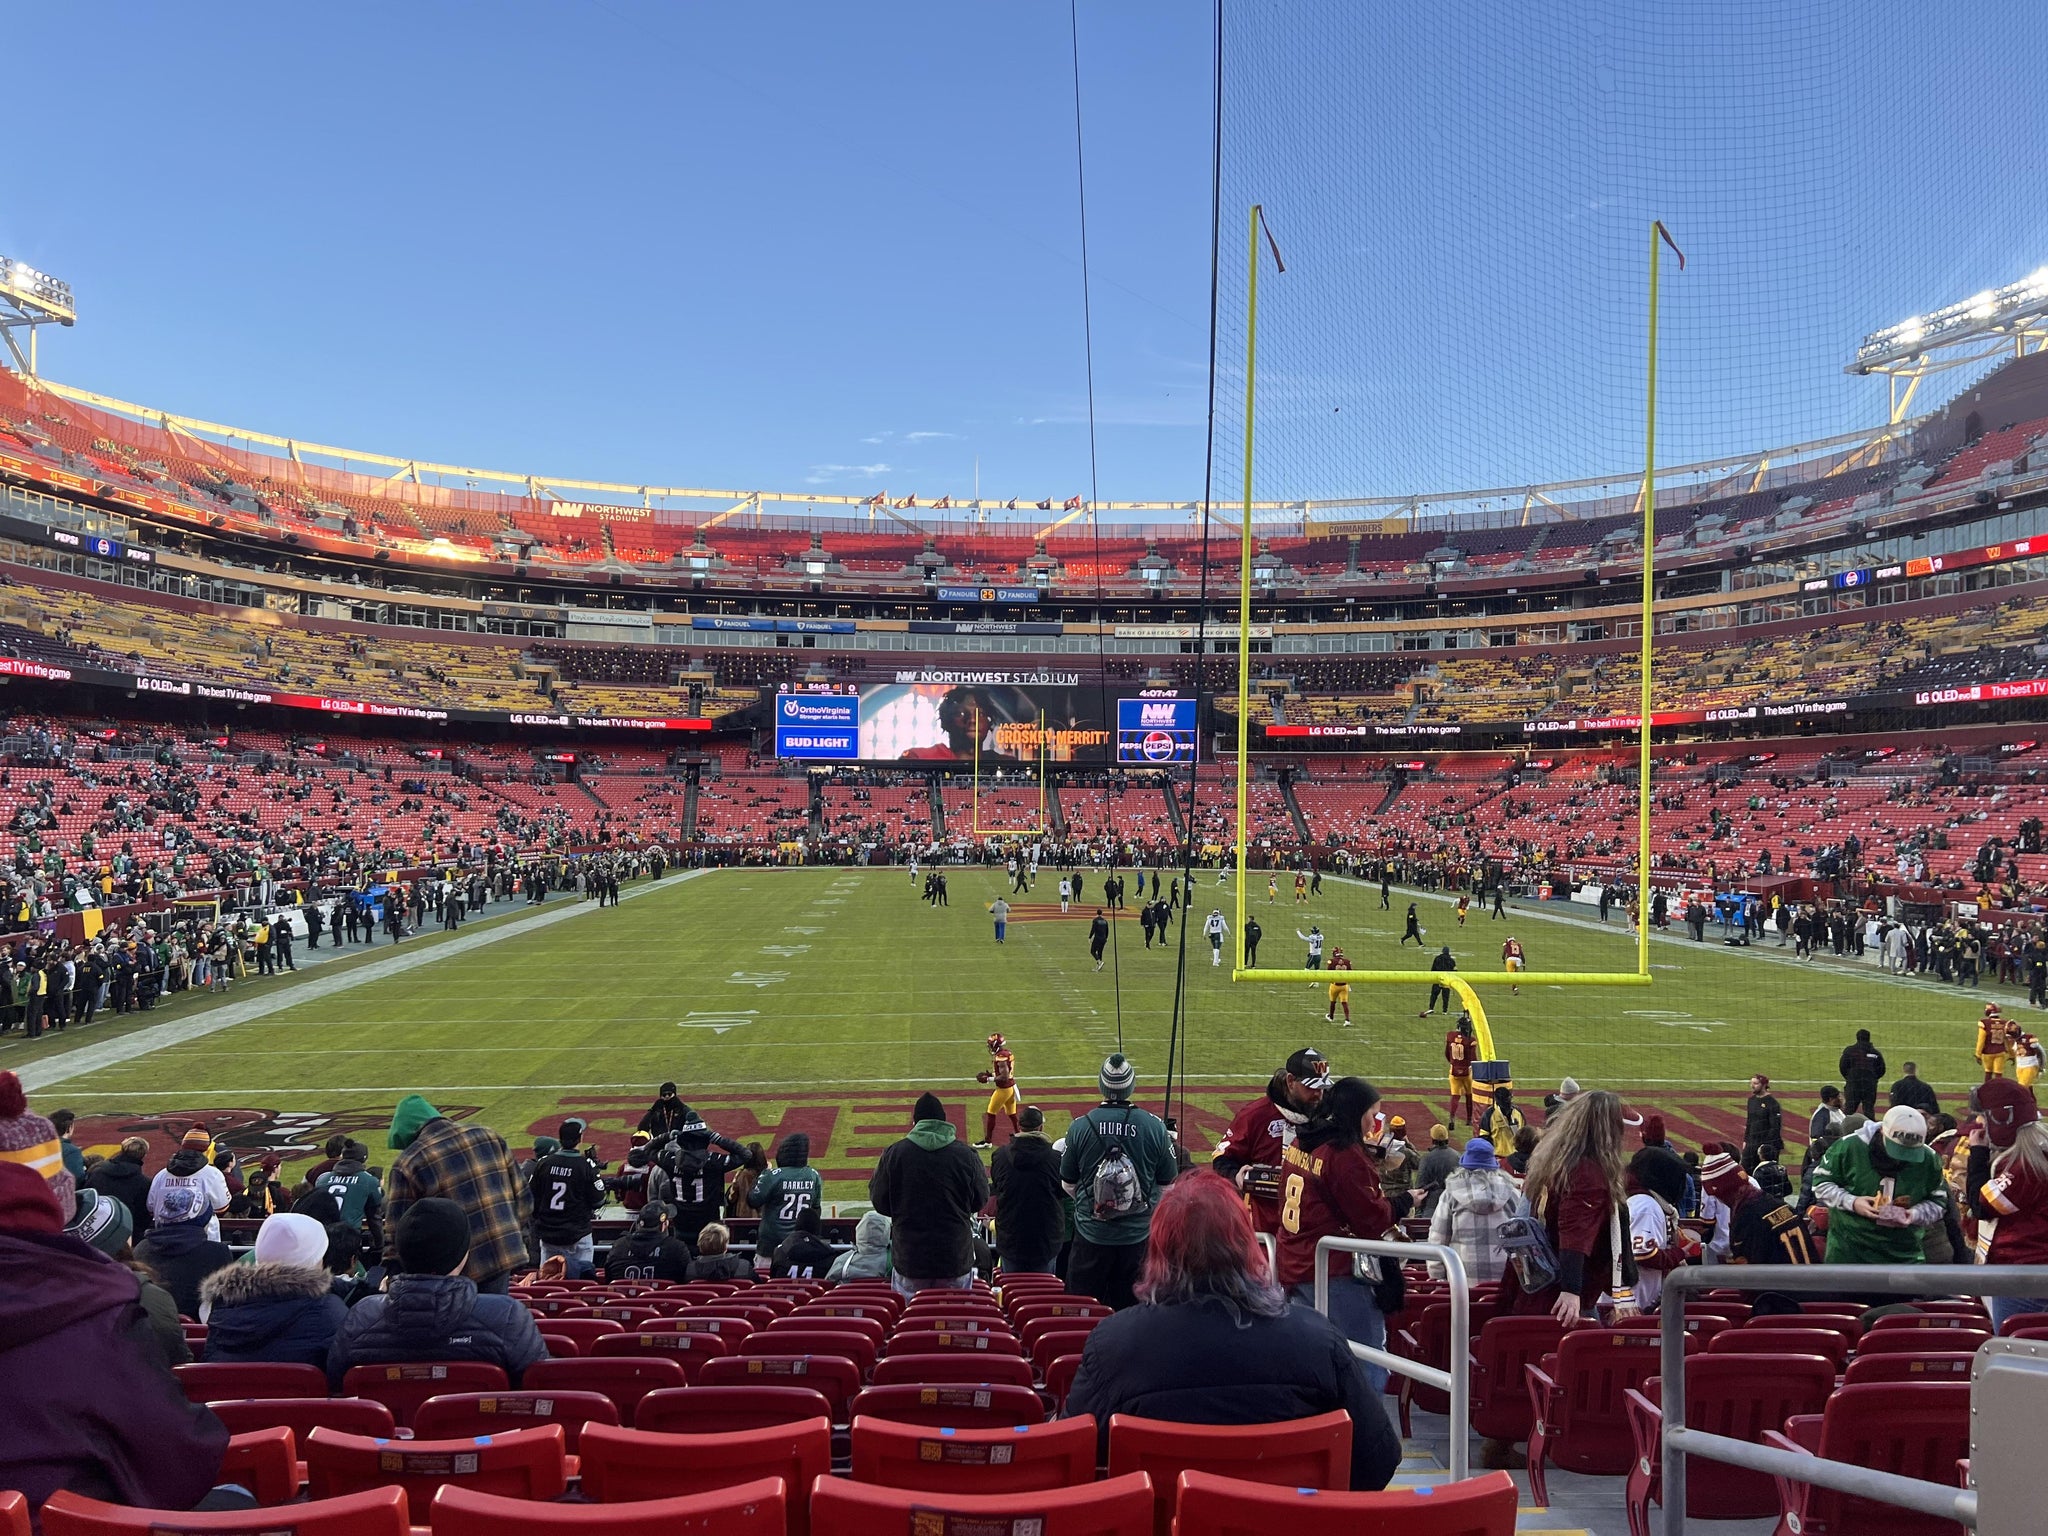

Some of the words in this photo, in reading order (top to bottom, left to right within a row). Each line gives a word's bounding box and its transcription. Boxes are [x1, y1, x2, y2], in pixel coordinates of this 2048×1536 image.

[586, 504, 652, 518] NORTHWEST
[600, 514, 638, 522] STADIUM
[1328, 524, 1382, 534] COMMANDERS
[54, 532, 79, 546] PEPSI
[127, 548, 150, 561] PEPSI
[1804, 580, 1828, 590] PEPSI
[1876, 566, 1902, 578] PEPSI
[982, 590, 993, 599] 25
[13, 662, 25, 673] TV
[26, 664, 34, 674] in
[34, 665, 47, 676] the
[48, 668, 71, 680] game
[921, 672, 1010, 682] NORTHWEST
[1013, 673, 1078, 683] STADIUM
[137, 678, 149, 690] LG
[150, 679, 173, 692] OLED
[1992, 686, 2009, 696] The
[2010, 684, 2031, 696] best
[2032, 682, 2046, 693] TV
[197, 685, 208, 696] The
[210, 686, 226, 698] best
[226, 688, 236, 699] TV
[236, 690, 243, 699] in
[243, 690, 253, 701] the
[254, 694, 272, 703] game
[1916, 692, 1930, 704] LG
[1932, 690, 1958, 703] OLED
[321, 700, 330, 709] LG
[332, 700, 350, 710] OLED
[370, 705, 382, 714] The
[383, 706, 398, 715] best
[398, 707, 408, 716] TV
[414, 708, 426, 717] the
[426, 710, 447, 719] game
[800, 706, 850, 714] OrthoVirginia
[1141, 704, 1176, 719] NW
[1706, 711, 1716, 720] LG
[1718, 710, 1740, 720] OLED
[1764, 707, 1778, 715] The
[1778, 705, 1794, 715] best
[1794, 705, 1805, 714] TV
[1805, 704, 1812, 712] in
[1813, 703, 1825, 712] the
[1826, 702, 1847, 713] game
[510, 714, 522, 723] LG
[524, 715, 549, 724] OLED
[577, 717, 591, 726] The
[593, 718, 610, 726] best
[611, 718, 622, 727] TV
[622, 719, 630, 727] in
[631, 719, 644, 727] the
[1524, 723, 1536, 731] LG
[1538, 722, 1560, 731] OLED
[1584, 720, 1596, 728] The
[1596, 719, 1610, 728] best
[1324, 727, 1347, 735] OLED
[1375, 726, 1389, 734] The
[786, 737, 812, 747] BUD
[813, 738, 849, 748] LIGHT
[1210, 919, 1220, 927] 47
[1100, 1122, 1137, 1137] HURTS
[165, 1178, 197, 1187] DANIELS
[328, 1176, 359, 1184] SMITH
[783, 1181, 814, 1190] BARKLEY
[550, 1182, 566, 1210] 2
[672, 1177, 704, 1202] 11
[1282, 1173, 1304, 1234] 8
[1780, 1226, 1810, 1264] 17
